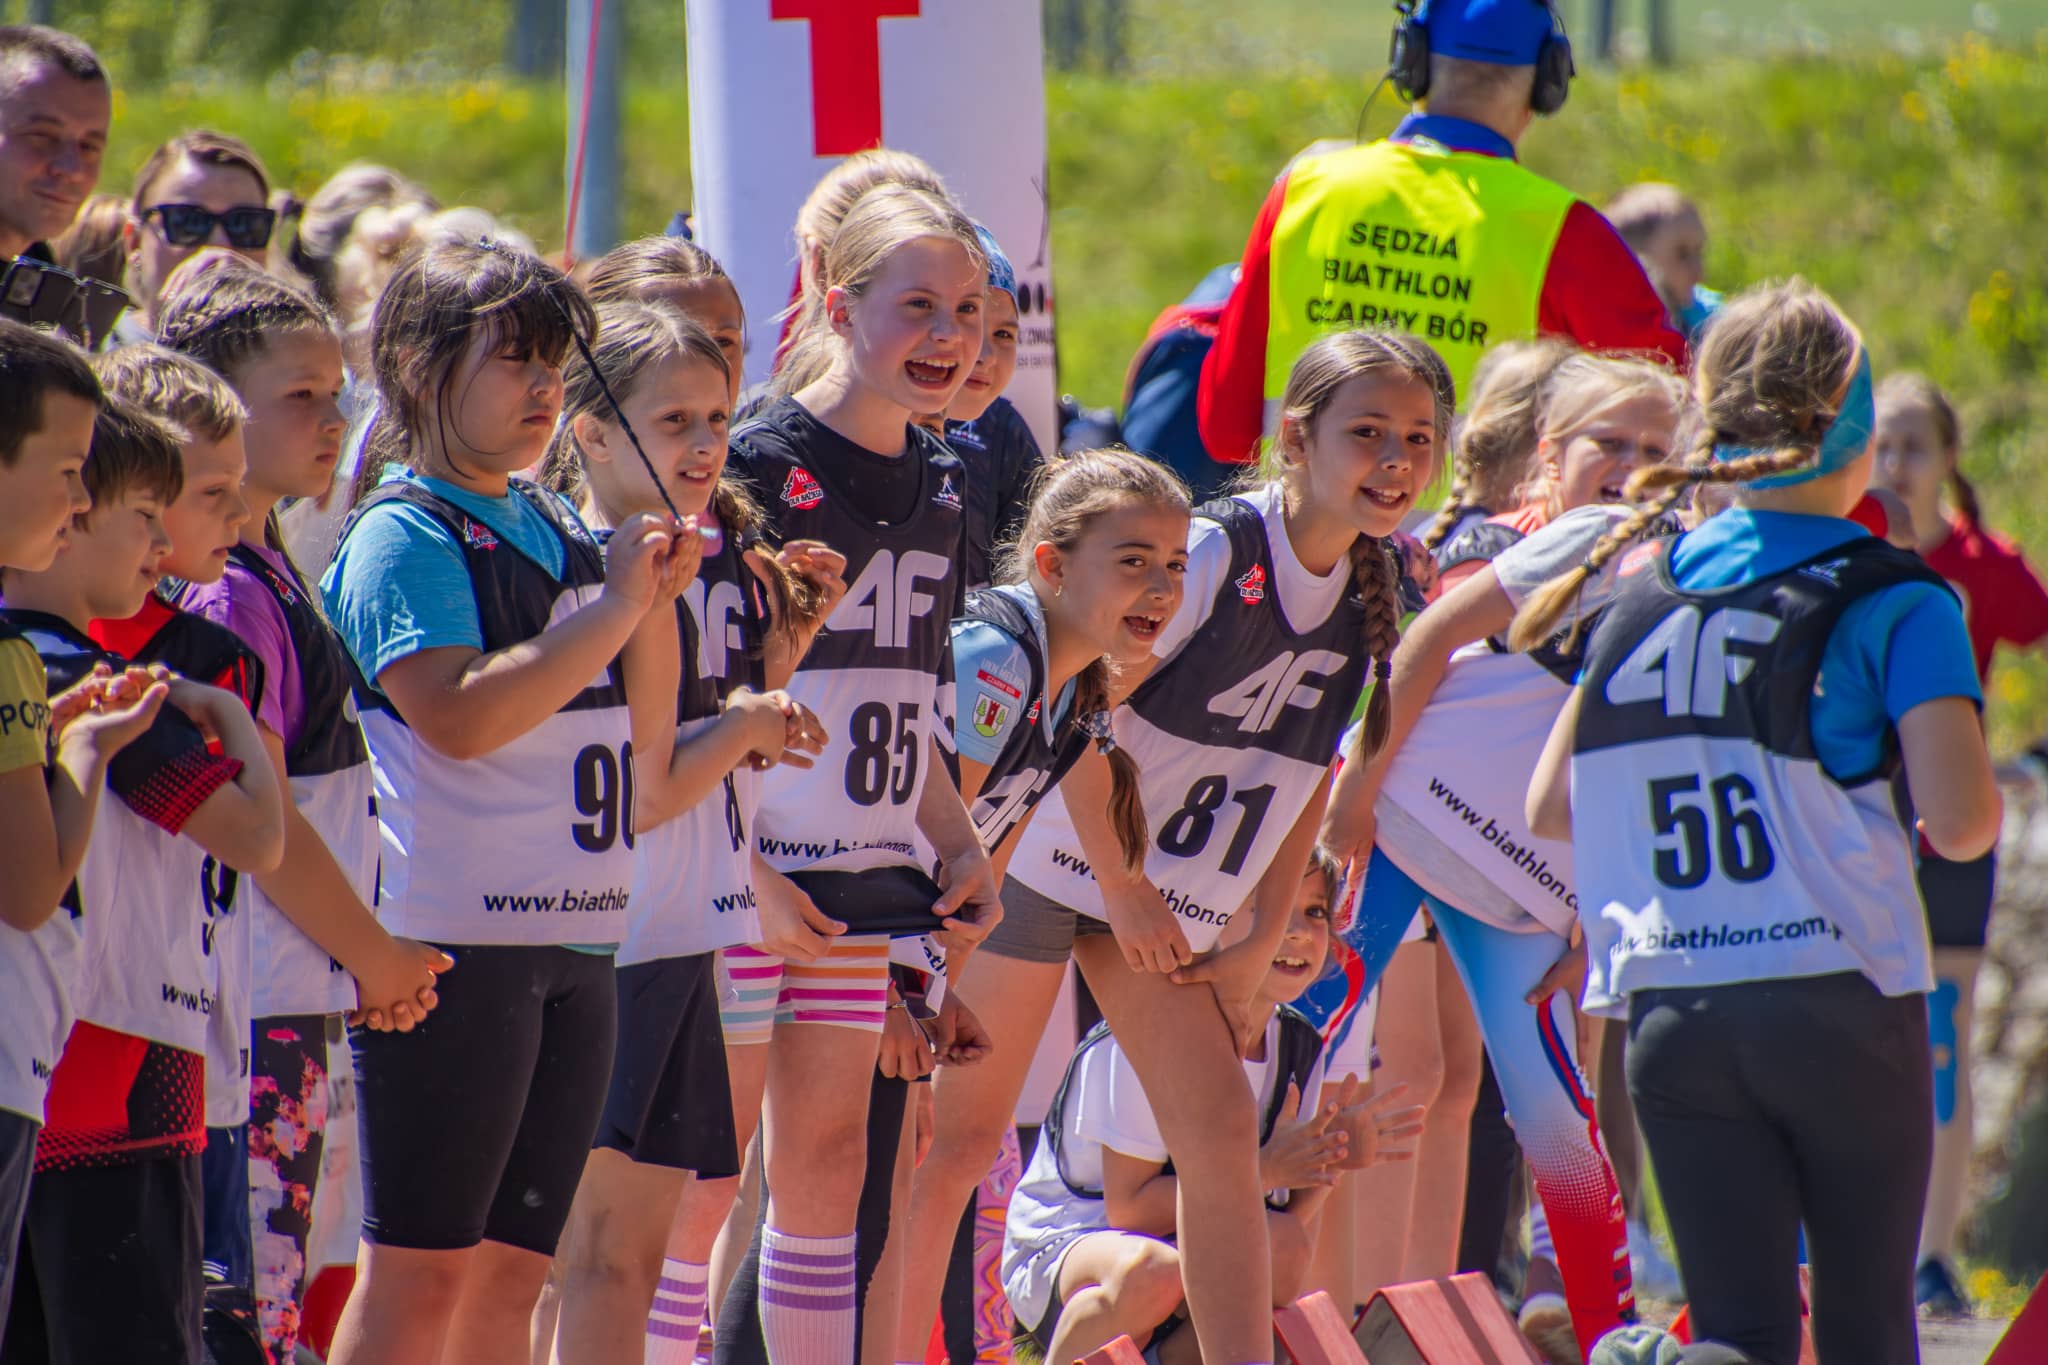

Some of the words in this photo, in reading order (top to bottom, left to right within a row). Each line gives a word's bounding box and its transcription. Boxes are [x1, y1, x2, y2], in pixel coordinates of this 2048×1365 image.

[1325, 258, 1472, 302] BIATHLON
[1349, 222, 1459, 259] SĘDZIA
[1305, 298, 1419, 331] CZARNY
[1427, 309, 1488, 347] BÓR
[824, 548, 951, 649] 4F
[1206, 649, 1349, 734] 4F
[1602, 604, 1784, 718] 4F
[571, 741, 636, 854] 90
[844, 700, 920, 807] 85
[1156, 774, 1278, 878] 81
[1428, 777, 1579, 911] www.biathlon.c
[1647, 773, 1776, 890] 56
